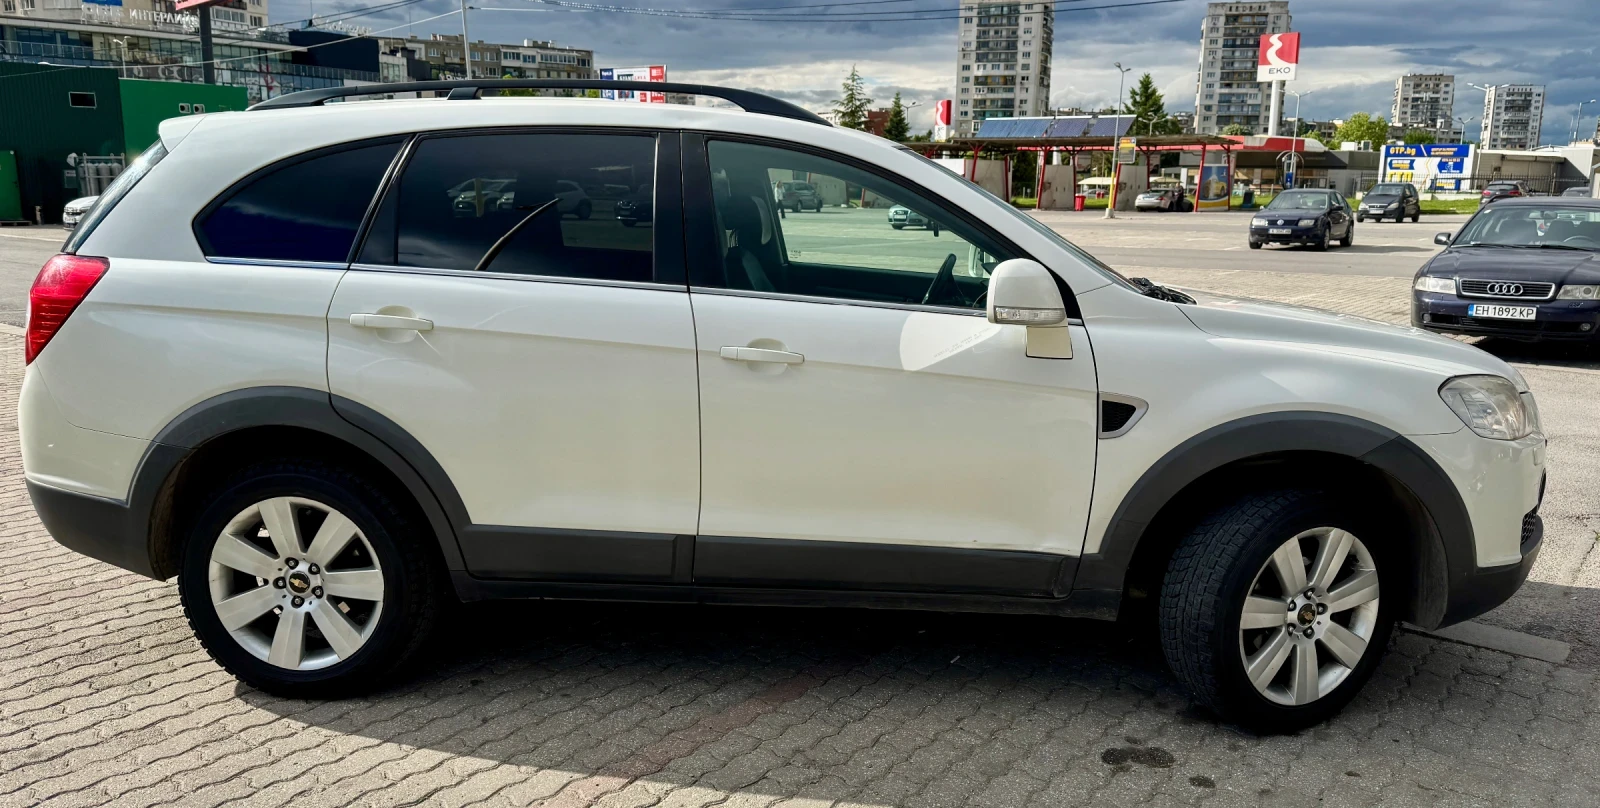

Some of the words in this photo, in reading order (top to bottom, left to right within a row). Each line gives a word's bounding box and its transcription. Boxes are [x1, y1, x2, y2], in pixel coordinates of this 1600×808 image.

[1390, 147, 1416, 156] GTP.bg
[1475, 306, 1489, 315] EH
[1493, 306, 1517, 317] 1892
[1519, 308, 1534, 318] KP
